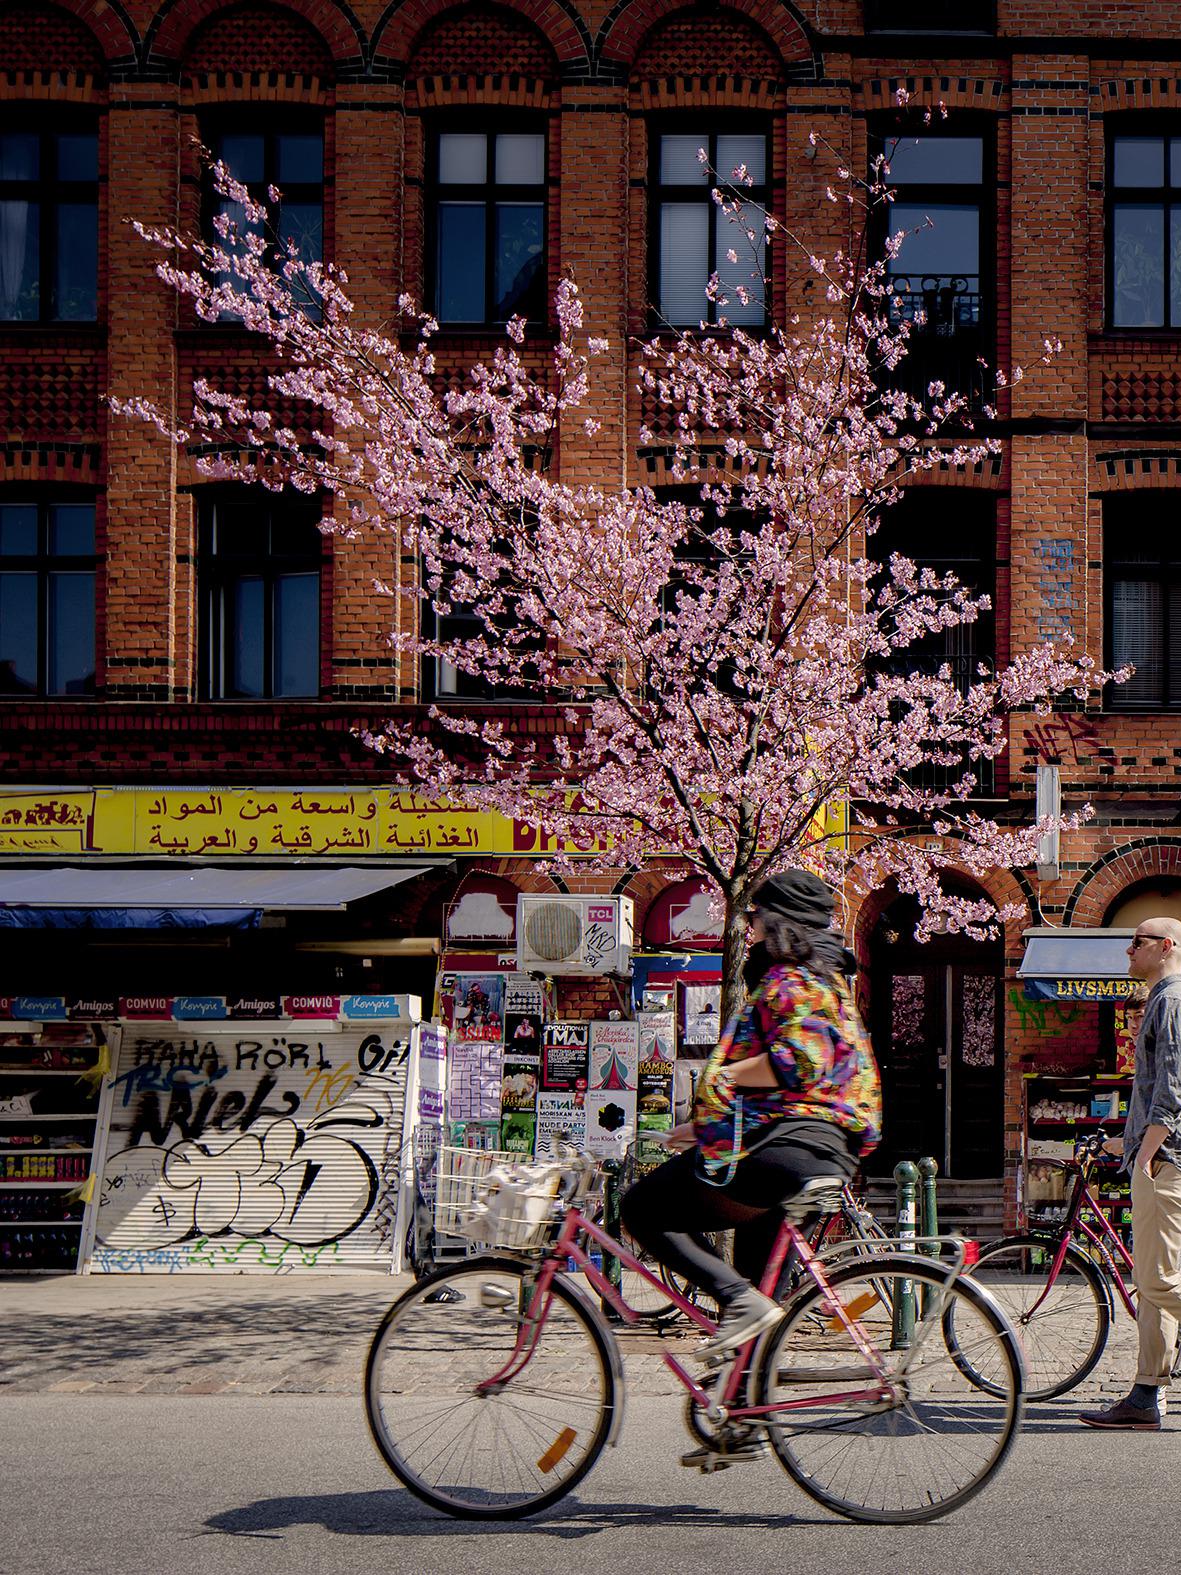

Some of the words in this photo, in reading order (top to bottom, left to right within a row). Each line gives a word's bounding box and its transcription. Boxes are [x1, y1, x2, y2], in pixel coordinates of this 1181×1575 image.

[148, 794, 223, 821] المواد
[239, 798, 278, 820] من
[270, 823, 371, 854] الشرقية
[589, 909, 613, 919] TCL
[72, 999, 115, 1015] Amigos
[126, 998, 167, 1009] COMVIQ
[234, 998, 276, 1014] Amigos
[292, 997, 333, 1008] COMVIQ
[542, 1031, 549, 1045] 1
[553, 1030, 588, 1046] MAJ
[539, 1121, 562, 1129] NUDE
